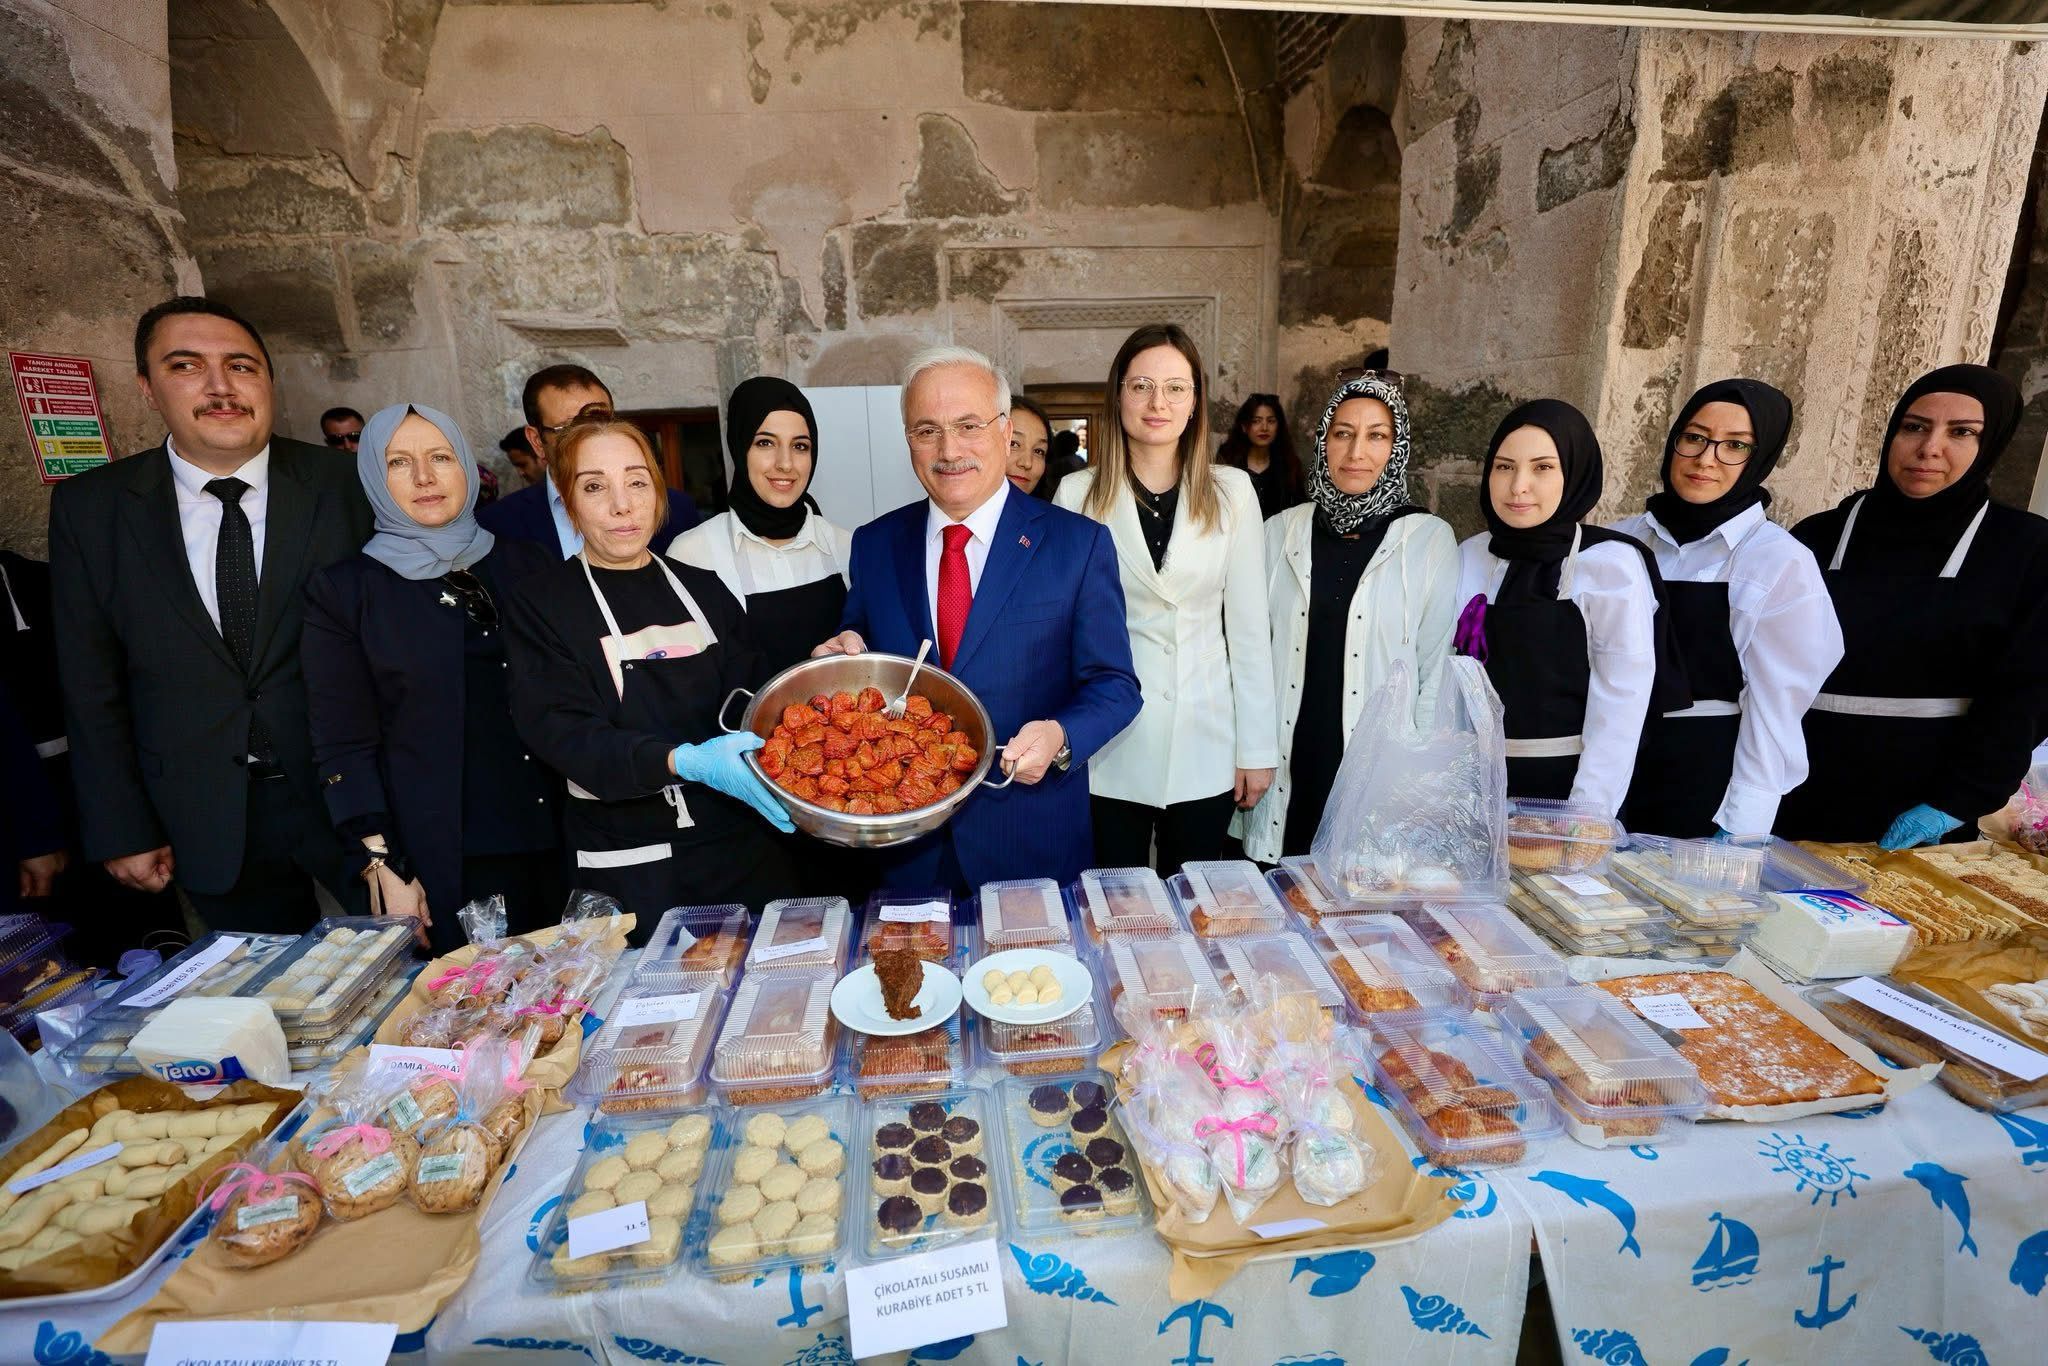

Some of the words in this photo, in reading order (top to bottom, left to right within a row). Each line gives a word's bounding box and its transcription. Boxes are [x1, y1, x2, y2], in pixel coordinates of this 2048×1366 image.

[155, 1063, 211, 1081] Teno
[874, 1274, 938, 1300] ÇİKOLATALI
[940, 1262, 989, 1282] SUSAMLI
[876, 1294, 932, 1318] KURABİYE
[936, 1288, 963, 1303] ADET
[966, 1285, 974, 1296] 5
[976, 1282, 988, 1293] TL
